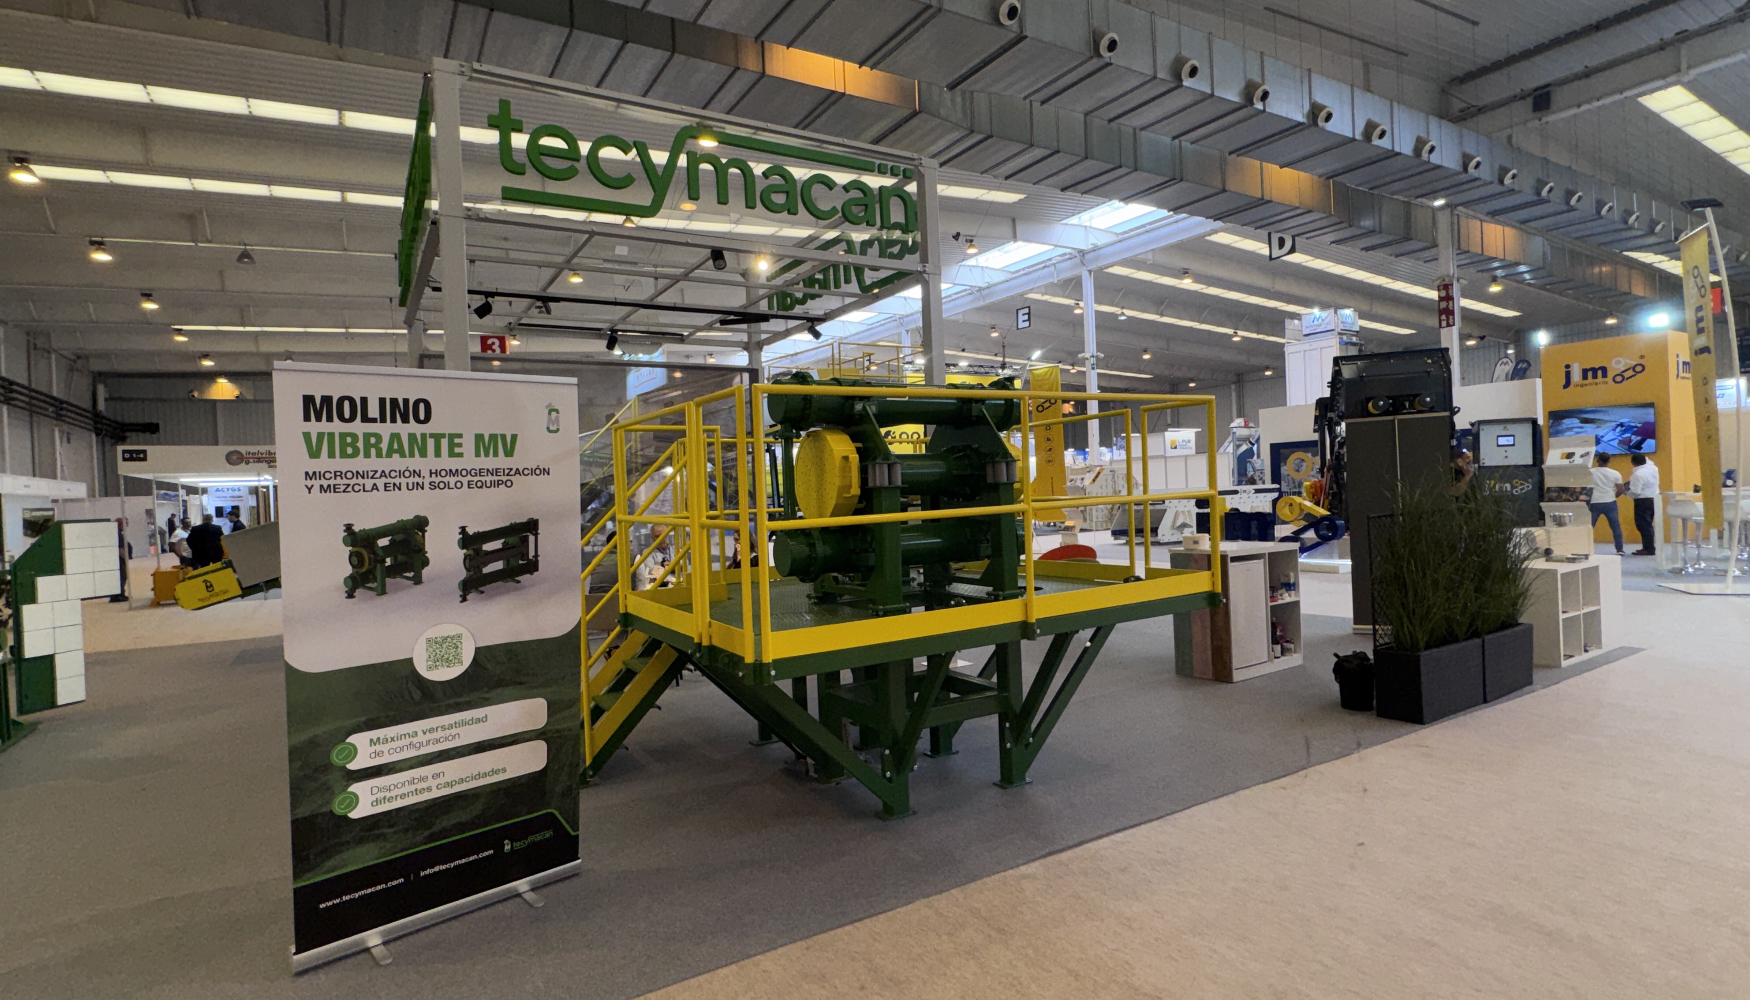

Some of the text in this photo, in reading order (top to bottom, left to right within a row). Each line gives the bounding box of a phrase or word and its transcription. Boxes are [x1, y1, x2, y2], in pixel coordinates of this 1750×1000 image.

[487, 98, 919, 234] tecymacan
[1271, 232, 1293, 259] D
[1018, 307, 1030, 329] E
[487, 338, 501, 354] 3
[1562, 362, 1608, 390] jlm
[302, 394, 433, 425] MOLINO
[302, 431, 519, 460] VIBRANTE MV
[304, 465, 551, 481] MICRONIZACIÓN, HOMOGENEIZACIÓN
[304, 478, 514, 495] Y MEZCLA EN UN SOLO EQUIPO
[369, 714, 489, 748] Máxima versatilidad
[369, 732, 461, 760] de configuración
[370, 771, 445, 796] Disponible en
[370, 765, 508, 808] diferentes capacidades
[319, 849, 494, 909] www.tecymacan.com info@tecymacan.com
